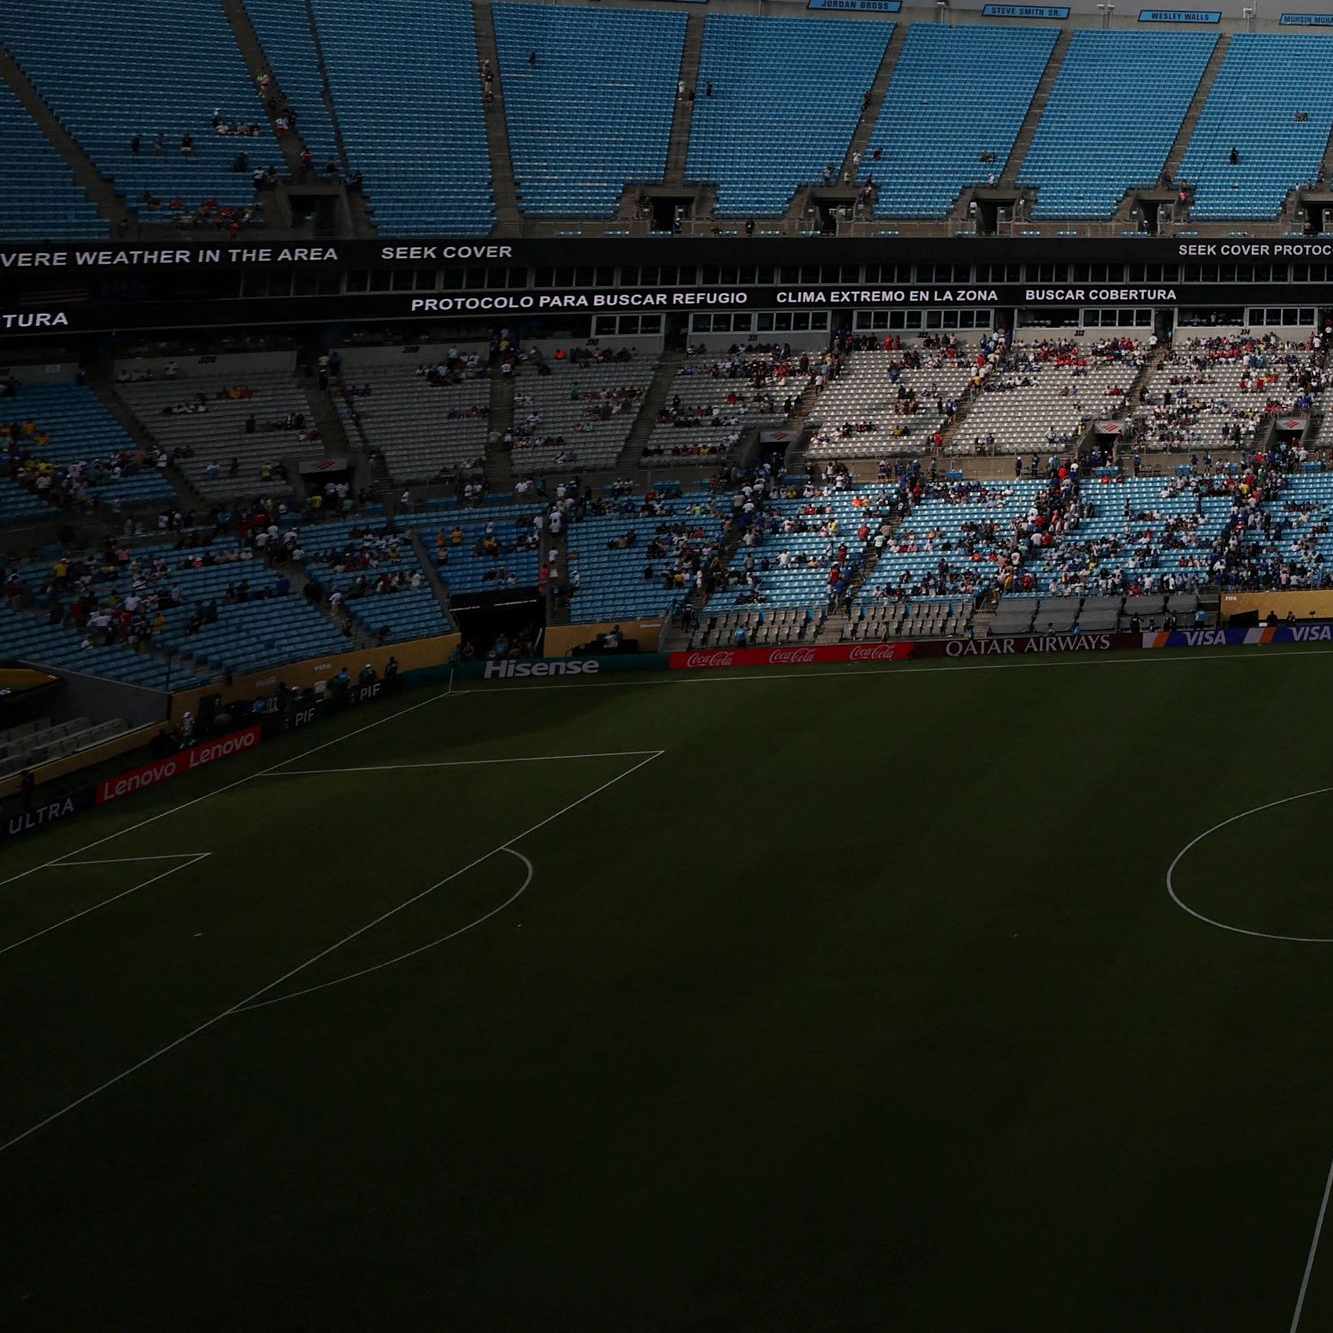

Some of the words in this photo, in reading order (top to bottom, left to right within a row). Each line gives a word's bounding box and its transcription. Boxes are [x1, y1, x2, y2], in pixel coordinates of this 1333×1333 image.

[821, 0, 857, 9] JORDAN
[991, 7, 1017, 15] STEVE
[1019, 8, 1045, 16] SMITH
[1151, 12, 1179, 21] WESLEY
[1184, 13, 1210, 21] WALLS
[1284, 16, 1312, 24] MUHSIN
[0, 253, 67, 266] VERE
[76, 250, 190, 265] WEATHER
[199, 250, 220, 263] IN
[228, 249, 271, 261] THE
[278, 248, 338, 261] AREA
[382, 247, 437, 259] SEEK
[443, 246, 511, 258] COVER
[1179, 245, 1216, 255] SEEK
[1221, 245, 1269, 255] COVER
[412, 296, 533, 311] PROTOCOLO
[539, 295, 588, 307] PARA
[594, 294, 667, 306] BUSCAR
[673, 293, 747, 304] REFUGIO
[777, 292, 826, 302] CLIMA
[830, 291, 905, 302] EXTREMO
[910, 291, 929, 301] EN
[934, 291, 953, 301] LA
[957, 290, 998, 301] ZONA
[1026, 290, 1084, 300] BUSCAR
[1089, 290, 1176, 300] COBERTURA
[3, 313, 68, 327] TURA
[1186, 631, 1226, 646] VISA
[1291, 626, 1331, 641] VISA
[850, 644, 896, 660] Coca-Cola
[946, 639, 1015, 657] QATAR
[1025, 635, 1110, 653] AIRWAYS
[687, 651, 736, 667] Coca-Cola
[769, 648, 816, 663] Coca-Cola
[484, 659, 599, 678] Hisense
[360, 683, 382, 700] PIF
[295, 707, 316, 726] PIF
[190, 733, 255, 768] Lenovo
[104, 762, 176, 800] Lenovo
[9, 798, 75, 834] ULTRA
